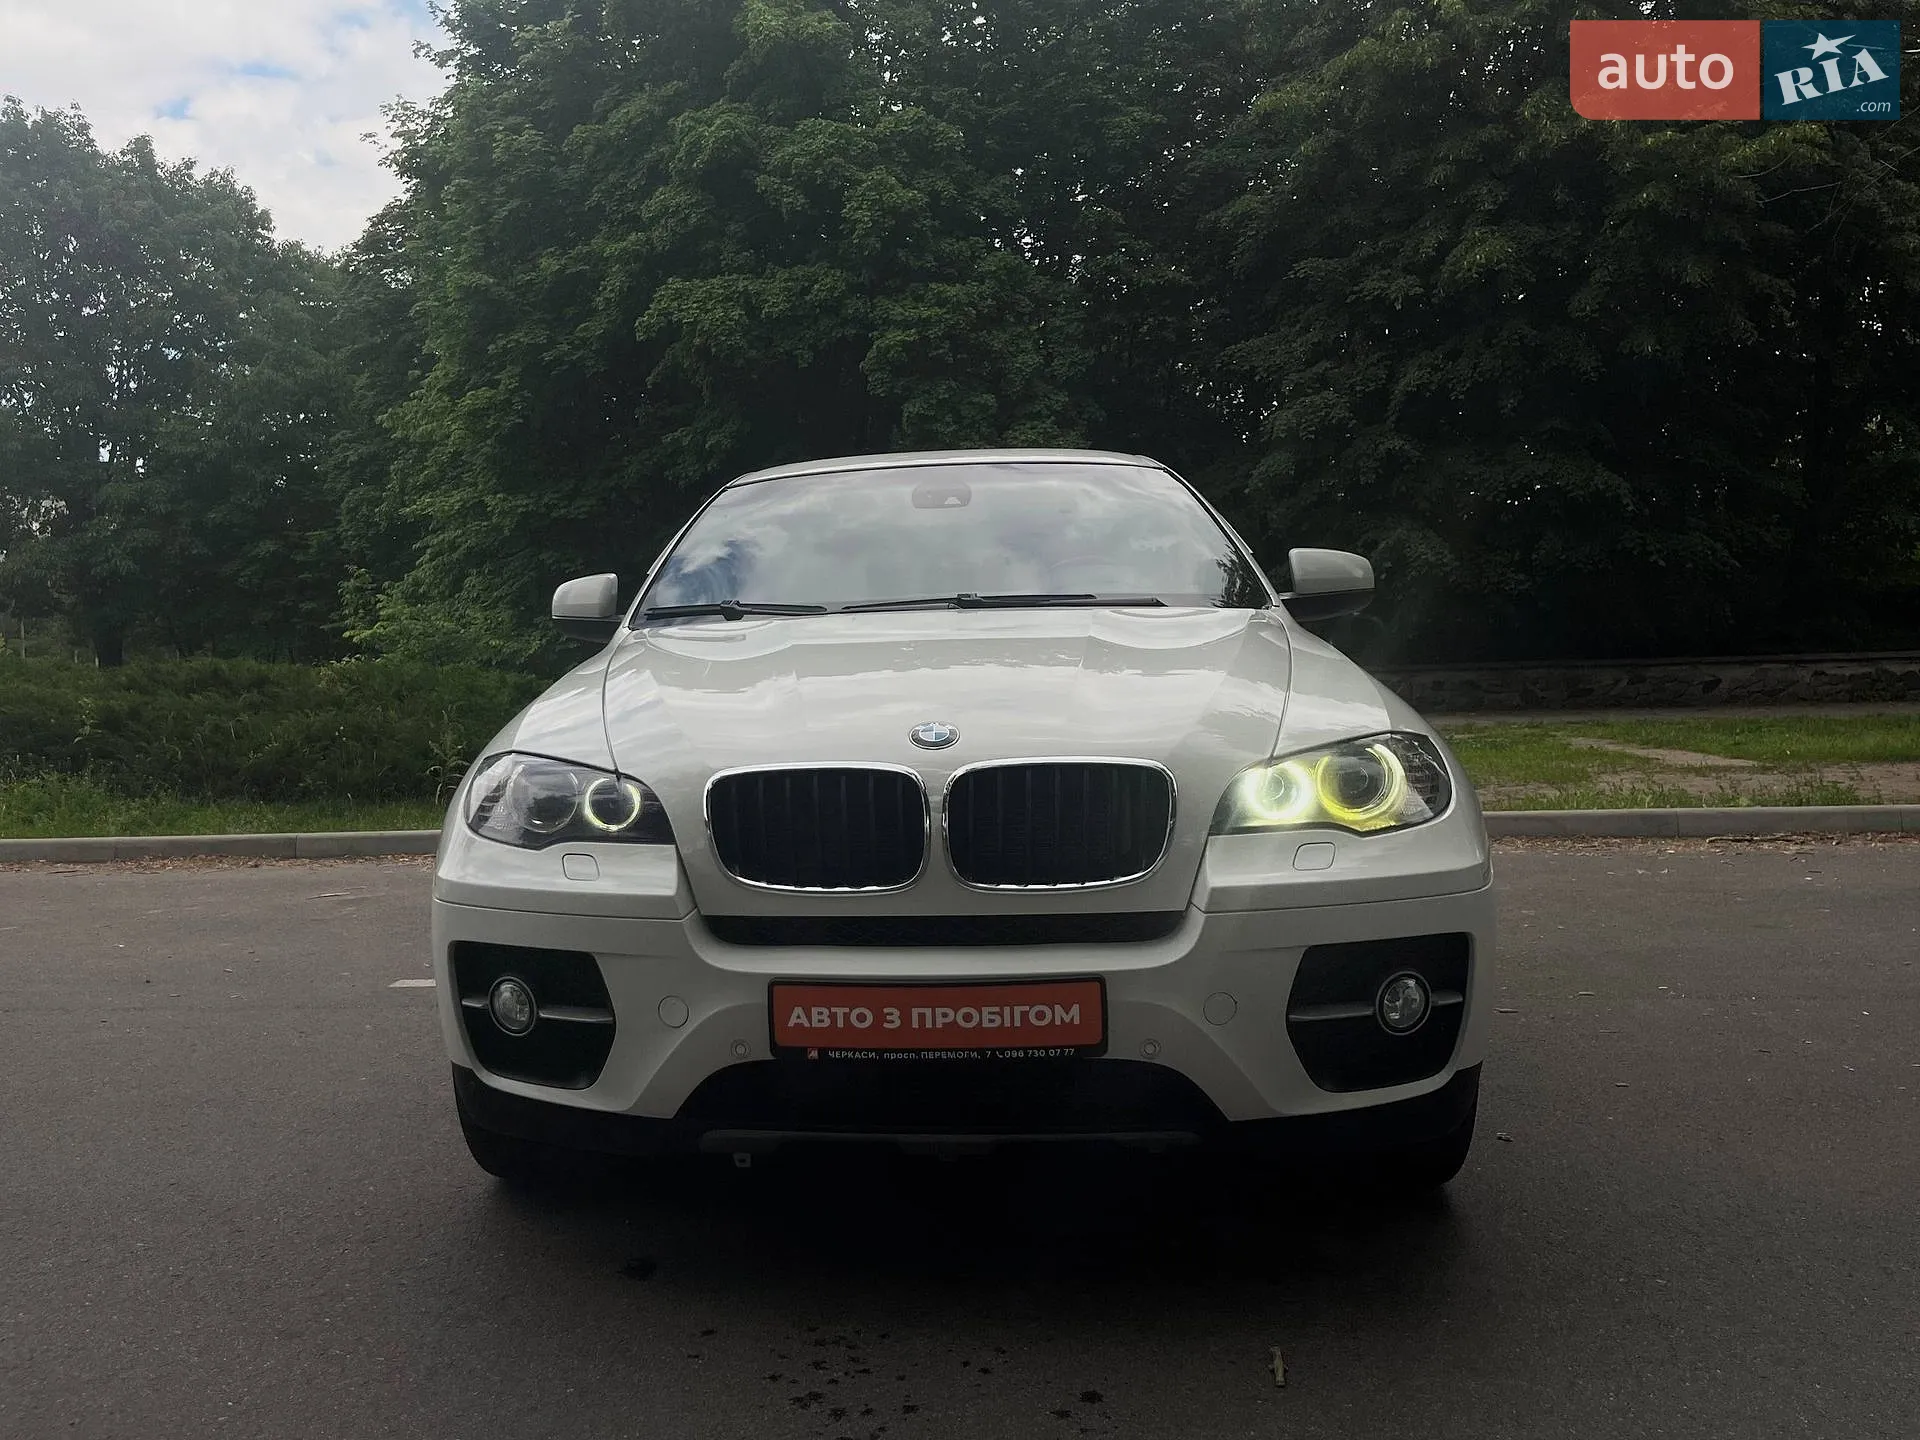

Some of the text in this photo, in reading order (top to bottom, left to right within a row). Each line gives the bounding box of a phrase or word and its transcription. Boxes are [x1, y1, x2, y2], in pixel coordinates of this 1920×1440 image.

[788, 1006, 873, 1028] АВТО
[912, 1004, 1080, 1028] ПРОБІГОМ
[828, 1050, 880, 1060] ЧЕРКАСИ,
[884, 1051, 918, 1060] просп.
[1027, 1048, 1045, 1057] 730
[1048, 1048, 1061, 1057] 07
[1063, 1047, 1075, 1056] 77
